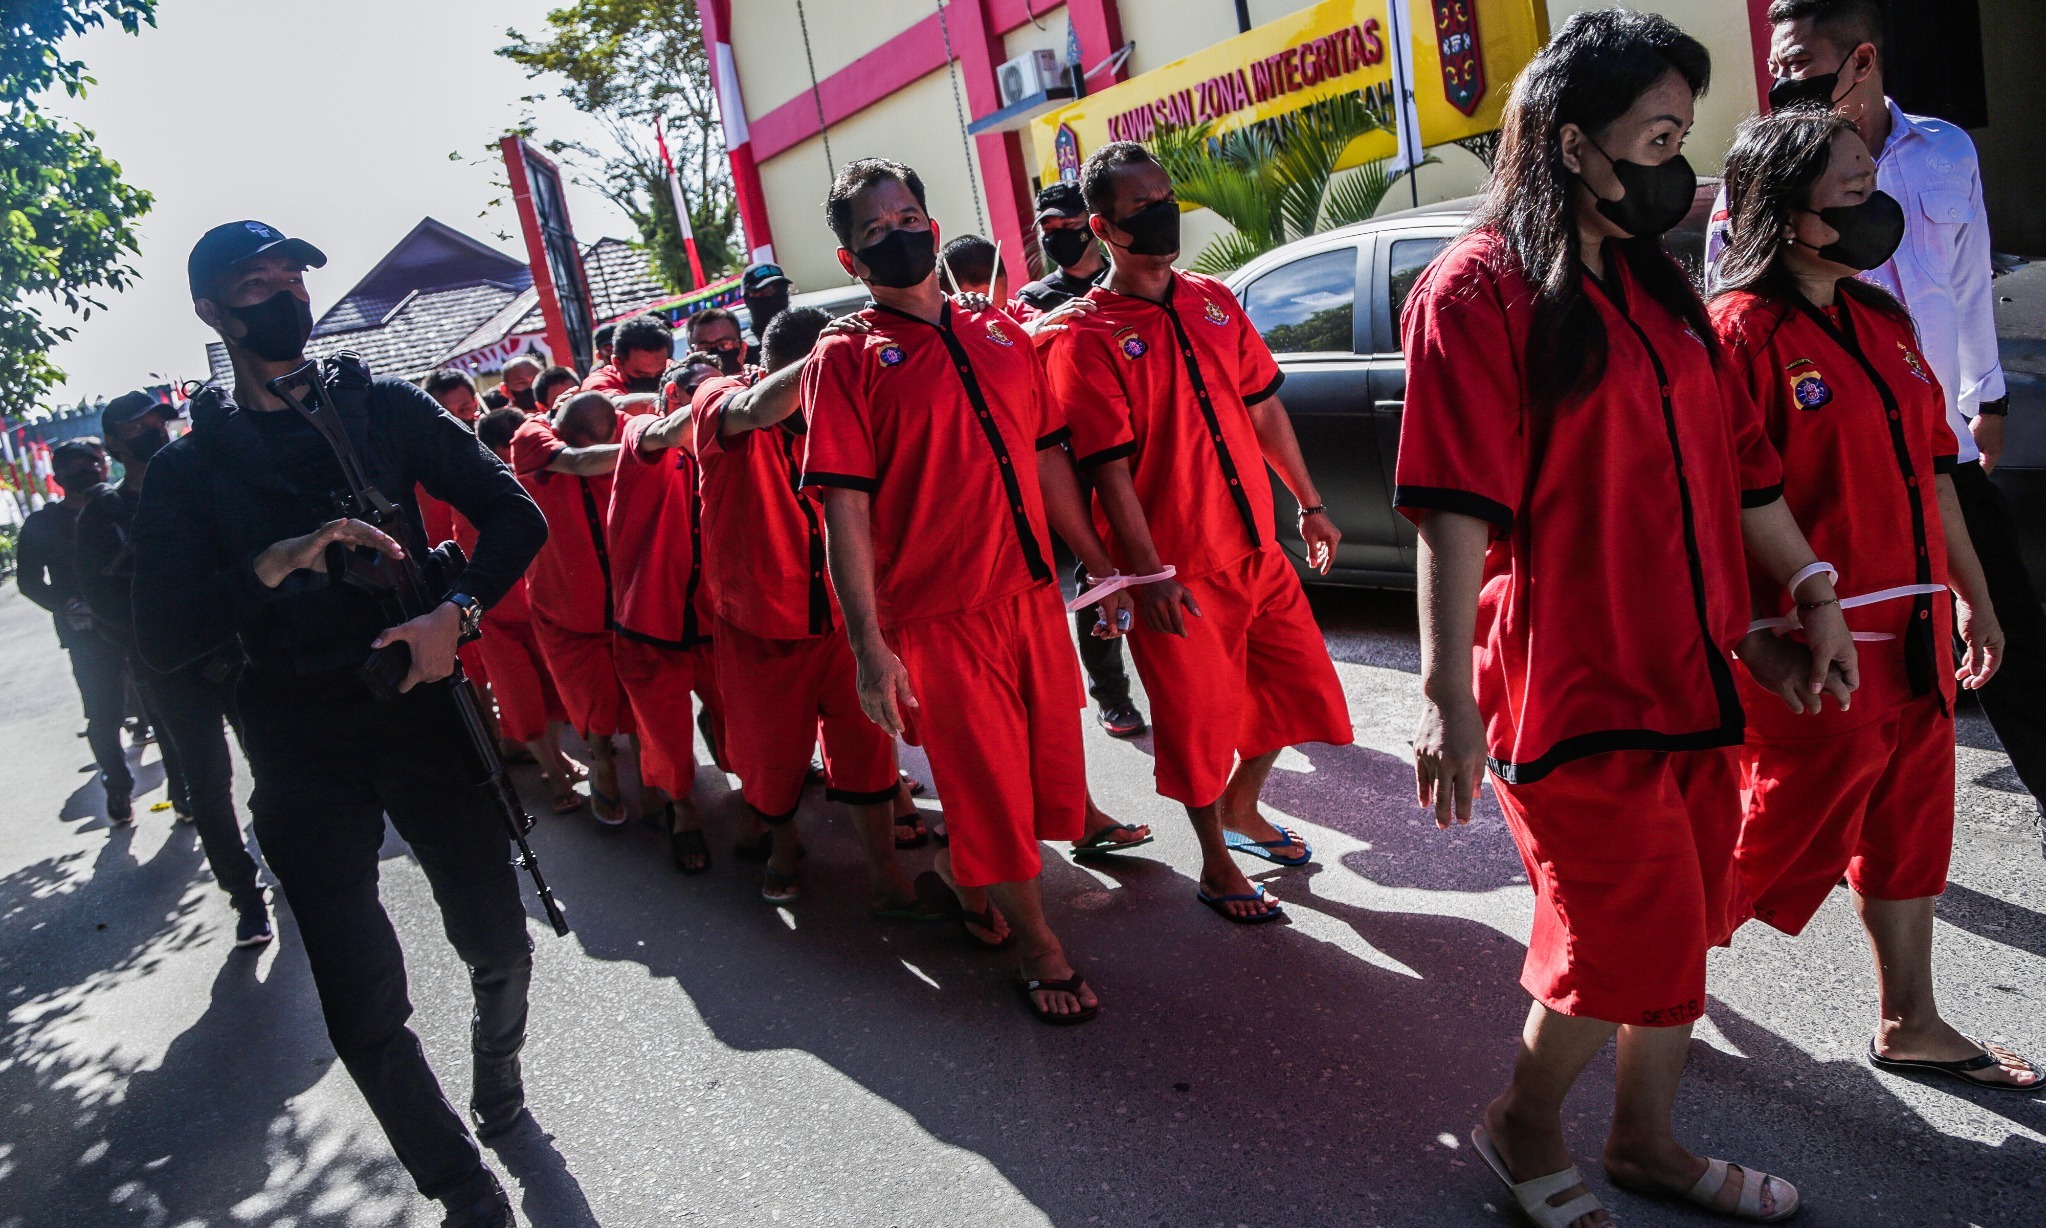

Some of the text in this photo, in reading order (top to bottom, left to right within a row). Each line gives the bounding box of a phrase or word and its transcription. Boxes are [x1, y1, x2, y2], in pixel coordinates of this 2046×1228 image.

[1108, 18, 1384, 143] KAWASAN ZONA INTEGRITAS
